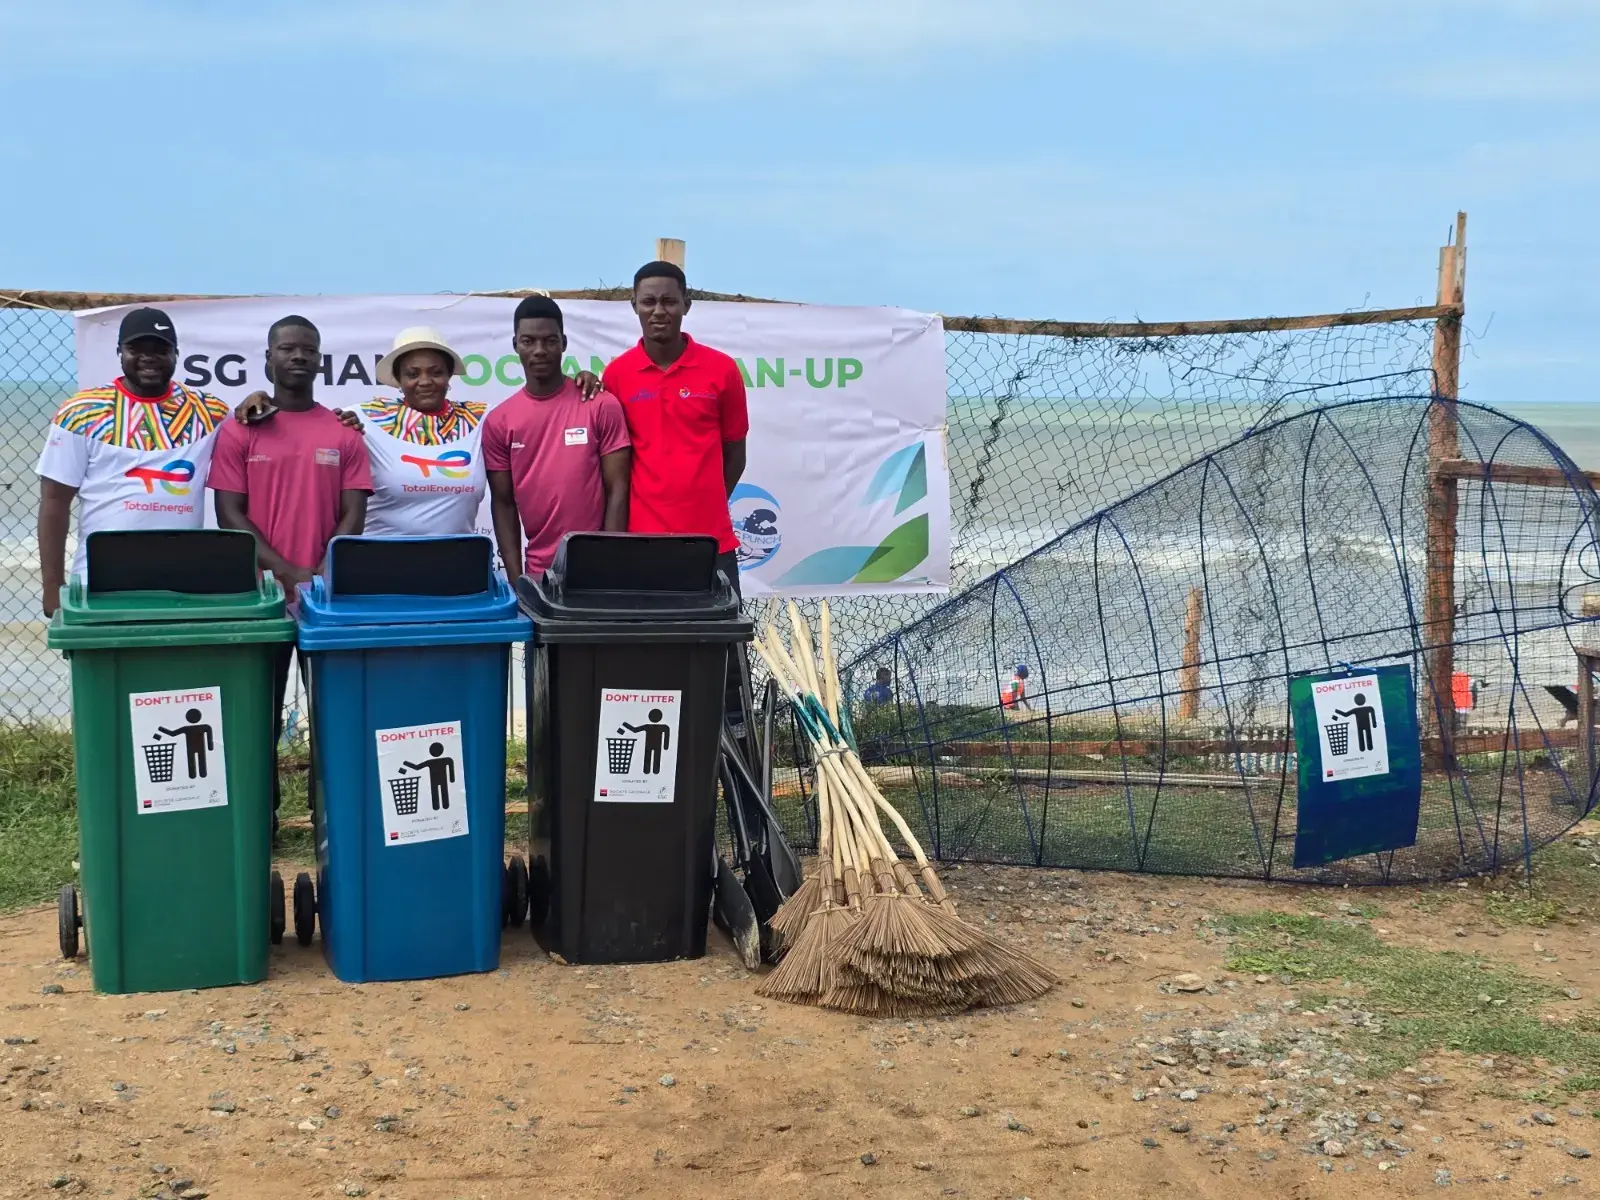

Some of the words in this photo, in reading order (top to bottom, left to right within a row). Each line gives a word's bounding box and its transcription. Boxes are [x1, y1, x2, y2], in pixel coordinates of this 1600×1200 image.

[183, 354, 247, 387] SG
[402, 484, 475, 494] TotalEnergies
[742, 532, 783, 545] PUNCH
[1315, 684, 1343, 694] DON'T
[1344, 679, 1373, 690] LITTER
[135, 696, 172, 707] DON'T
[175, 692, 214, 704] LITTER
[605, 694, 638, 702] DON'T
[641, 695, 675, 703] LITTER
[381, 731, 415, 742] DON'T
[419, 727, 454, 738] LITTER
